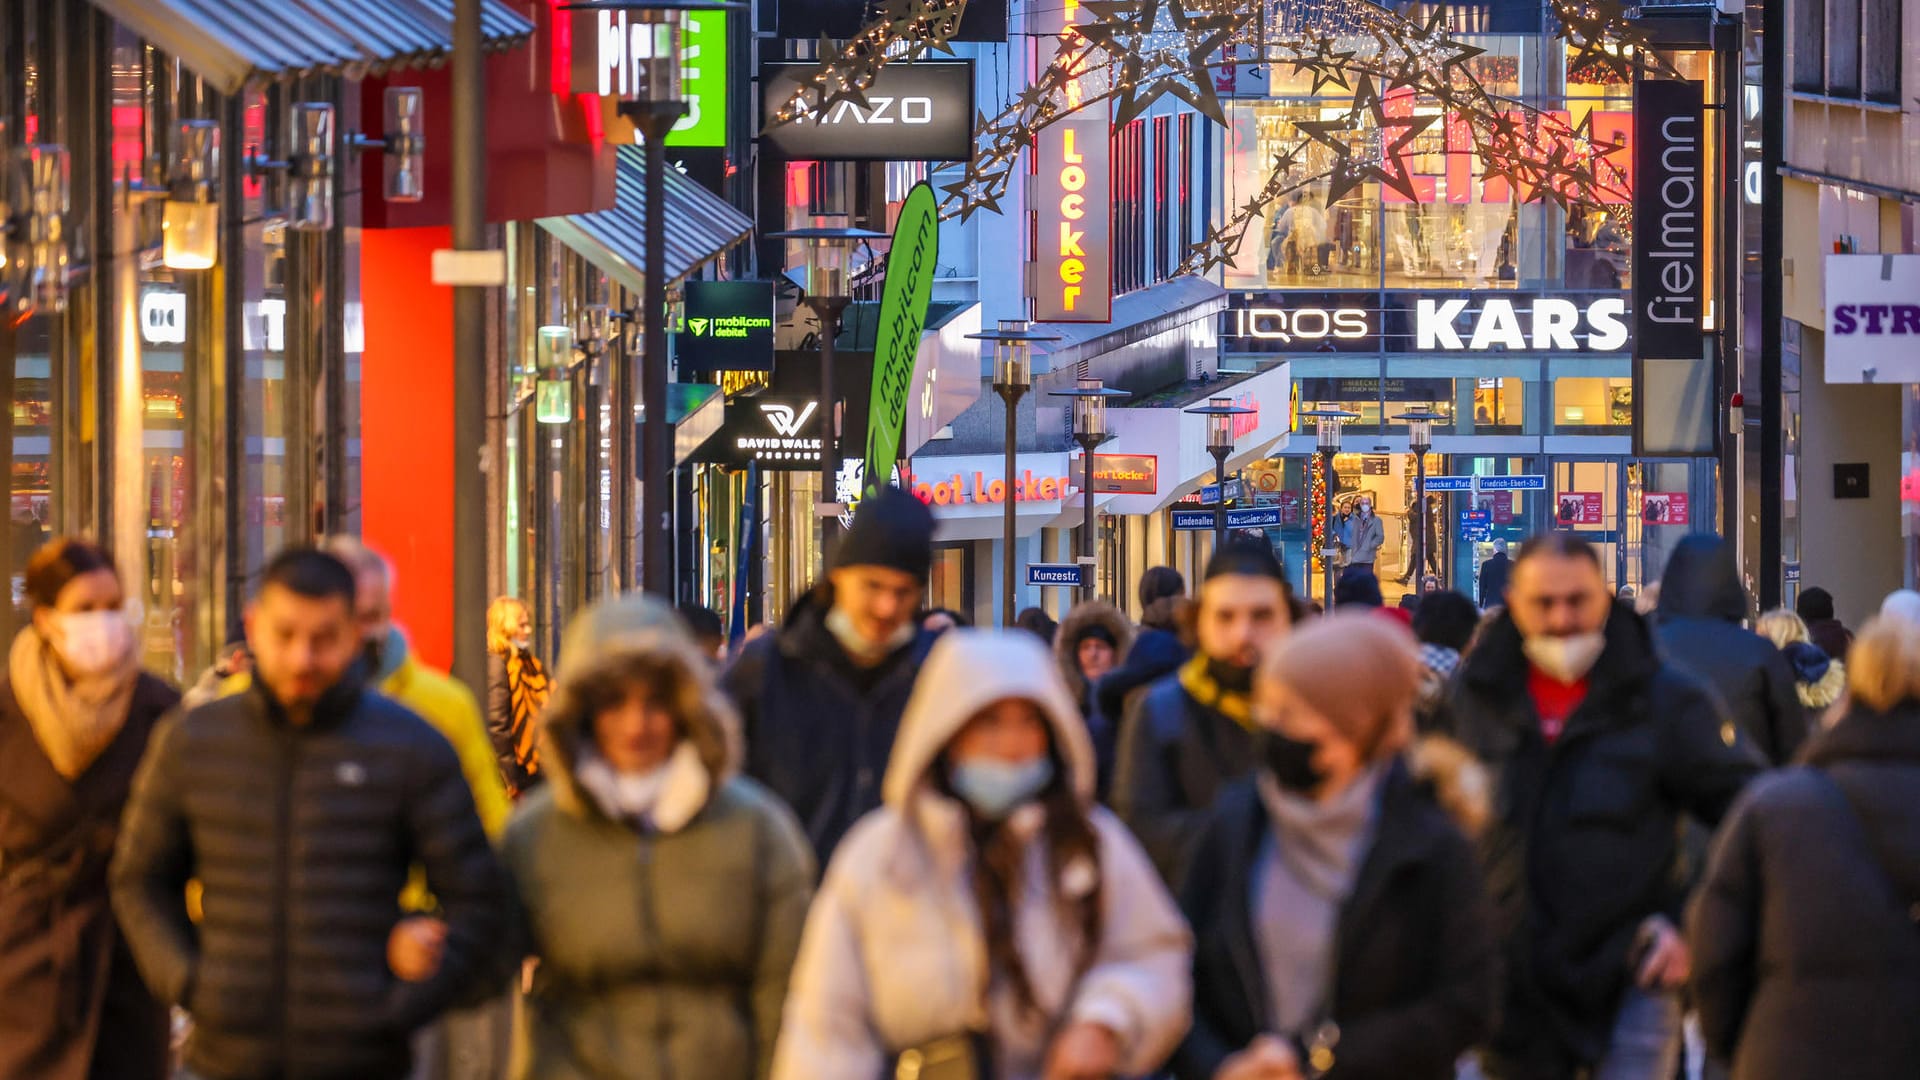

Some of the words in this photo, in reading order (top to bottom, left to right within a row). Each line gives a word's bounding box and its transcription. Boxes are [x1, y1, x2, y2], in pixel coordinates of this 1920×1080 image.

[795, 97, 932, 124] MAZO
[1060, 128, 1087, 312] Locker
[1647, 115, 1695, 323] fielmann
[880, 208, 932, 403] mobilcom
[715, 316, 770, 327] mobilcom
[715, 327, 748, 337] debitel
[1236, 309, 1368, 343] IQOS
[1416, 298, 1629, 350] KARS
[890, 313, 921, 429] debitel
[737, 438, 780, 449] DAVID
[1178, 516, 1214, 526] Lindenallee
[1034, 569, 1079, 582] Kunzestr.
